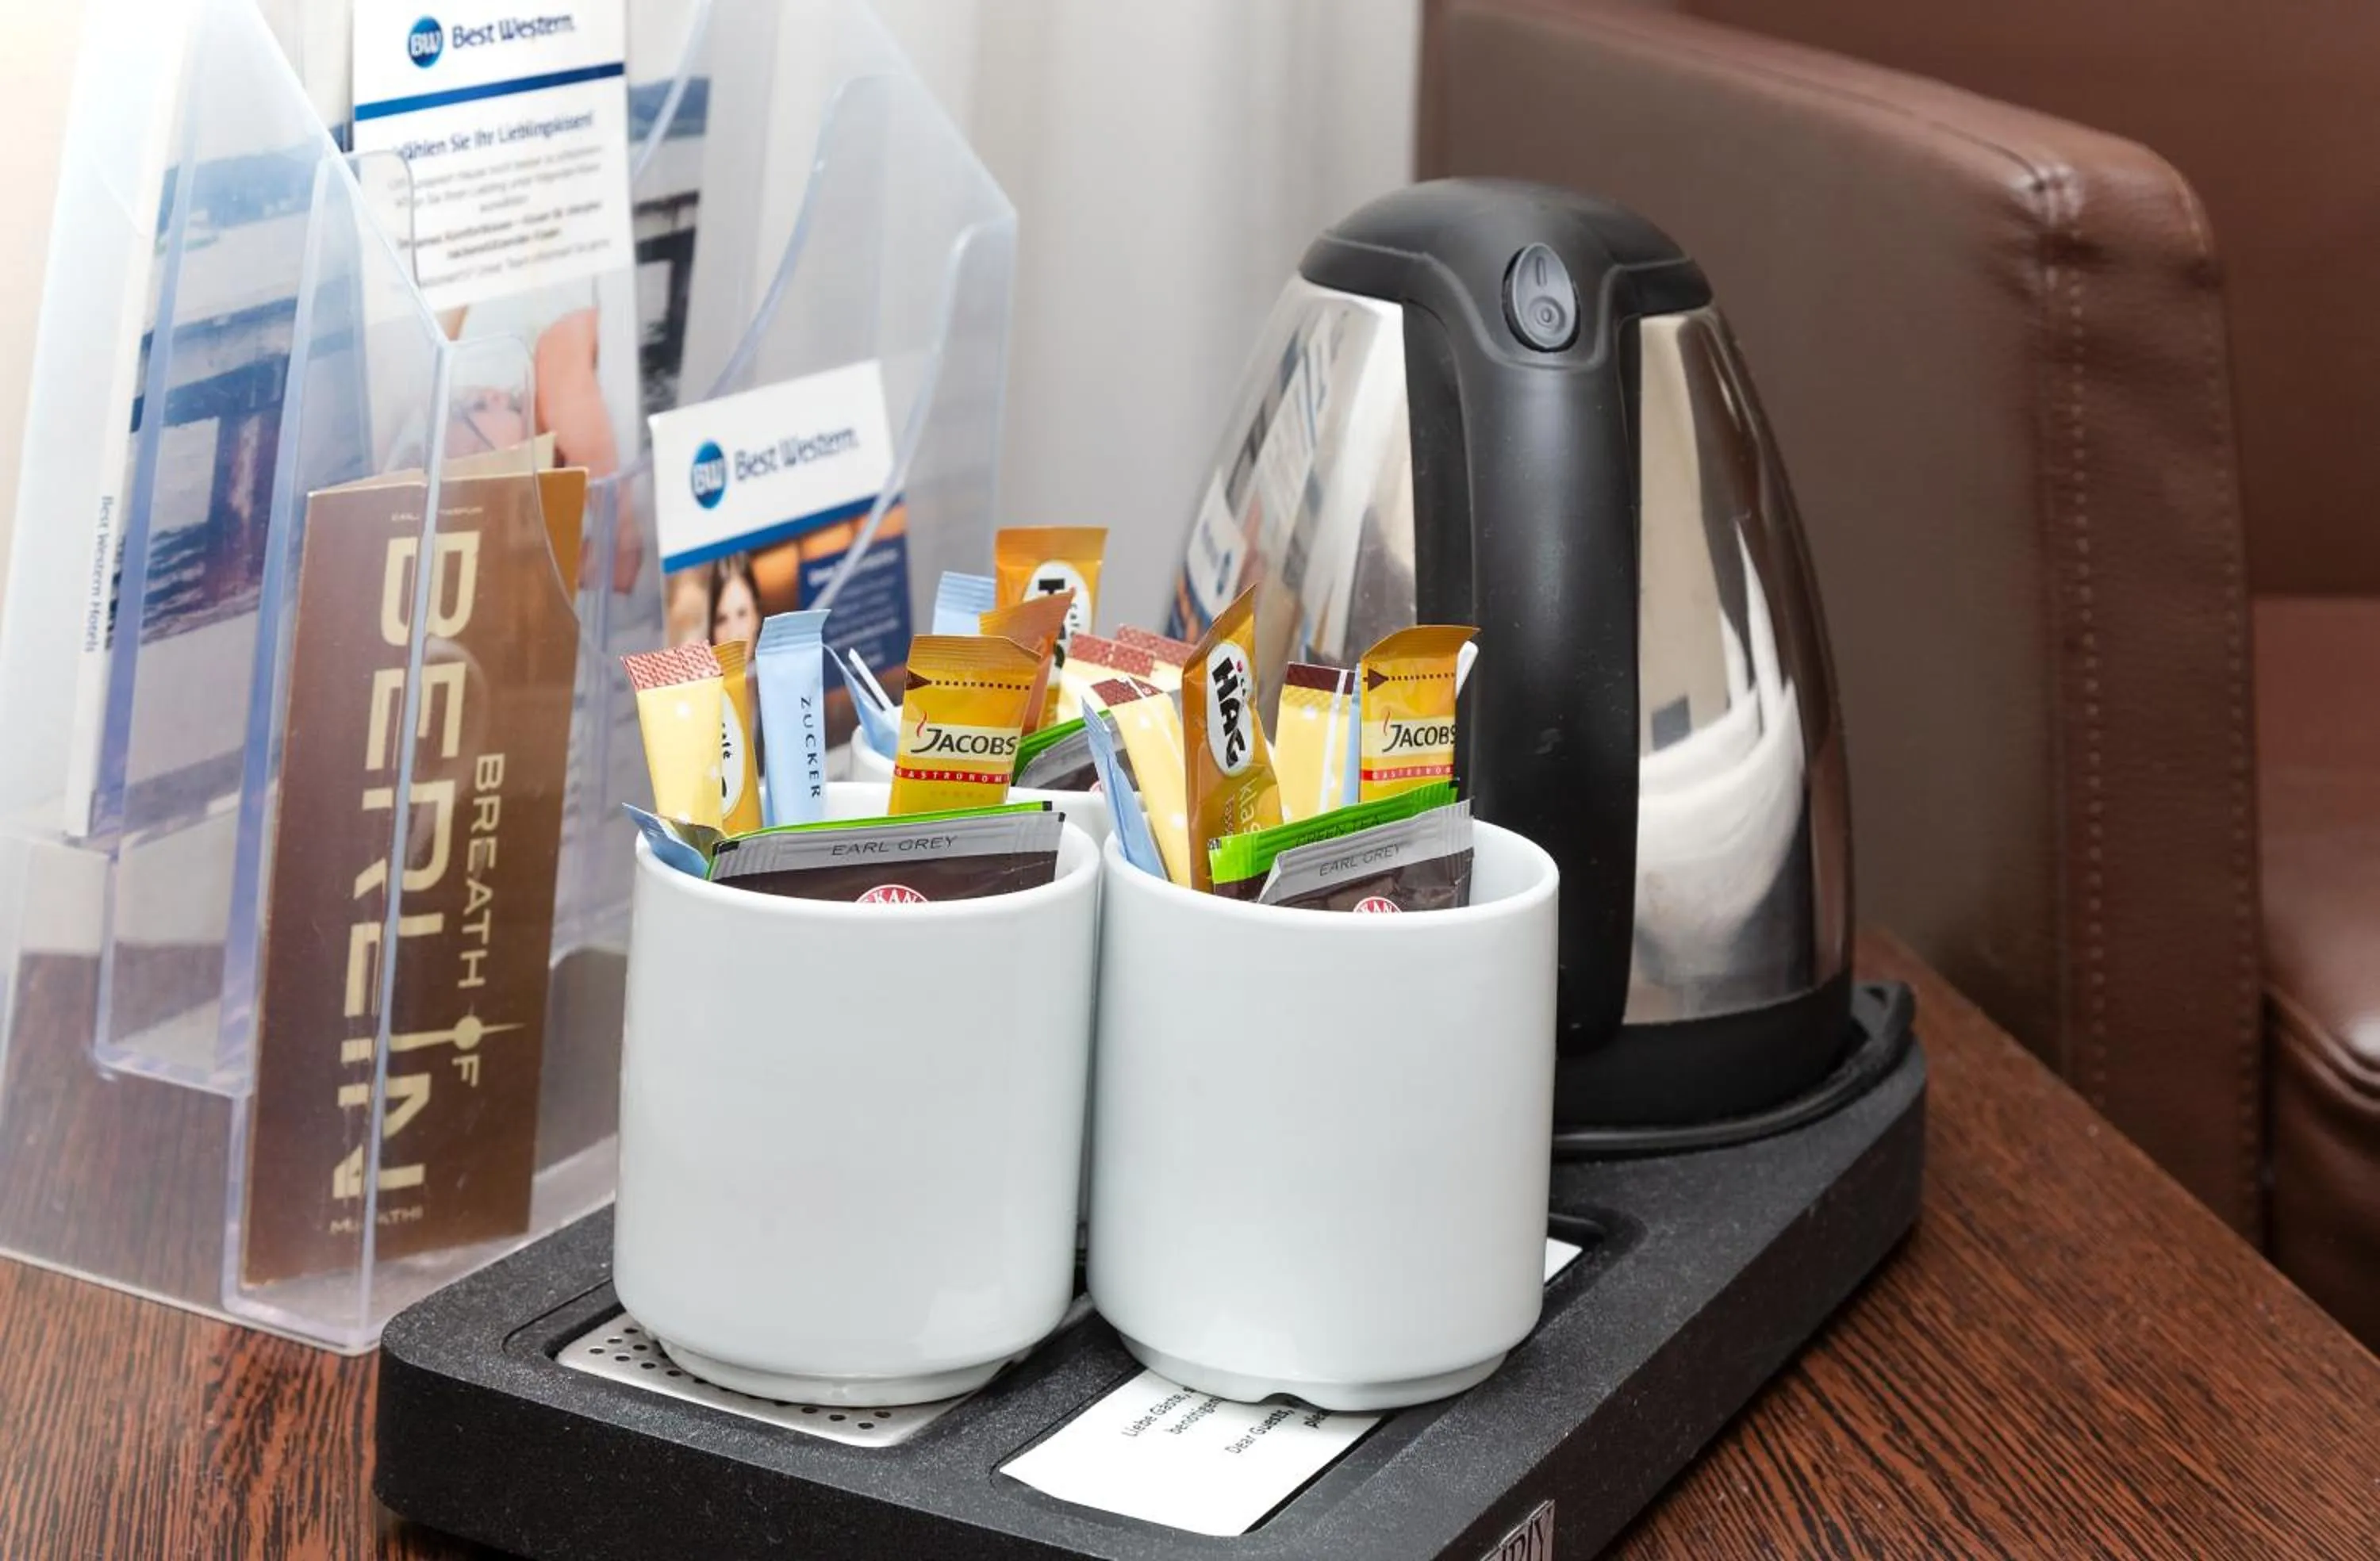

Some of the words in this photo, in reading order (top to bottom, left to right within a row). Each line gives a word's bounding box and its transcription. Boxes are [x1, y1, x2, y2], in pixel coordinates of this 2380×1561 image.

[452, 25, 494, 48] Best
[498, 14, 574, 40] Western
[735, 450, 777, 481] Best
[98, 495, 114, 528] Best
[91, 533, 109, 596] Western
[800, 696, 821, 799] ZUCKER
[910, 727, 1018, 756] JACOBS
[1382, 724, 1458, 753] JACOBS
[831, 841, 889, 856] EARL
[898, 835, 958, 852] GREY
[1319, 856, 1358, 876] EARL
[1362, 842, 1399, 865] GREY
[332, 530, 481, 1199] BERLIN
[458, 754, 505, 988] BREATH
[1224, 1434, 1256, 1453] Dear
[1249, 1409, 1295, 1435] Guests,
